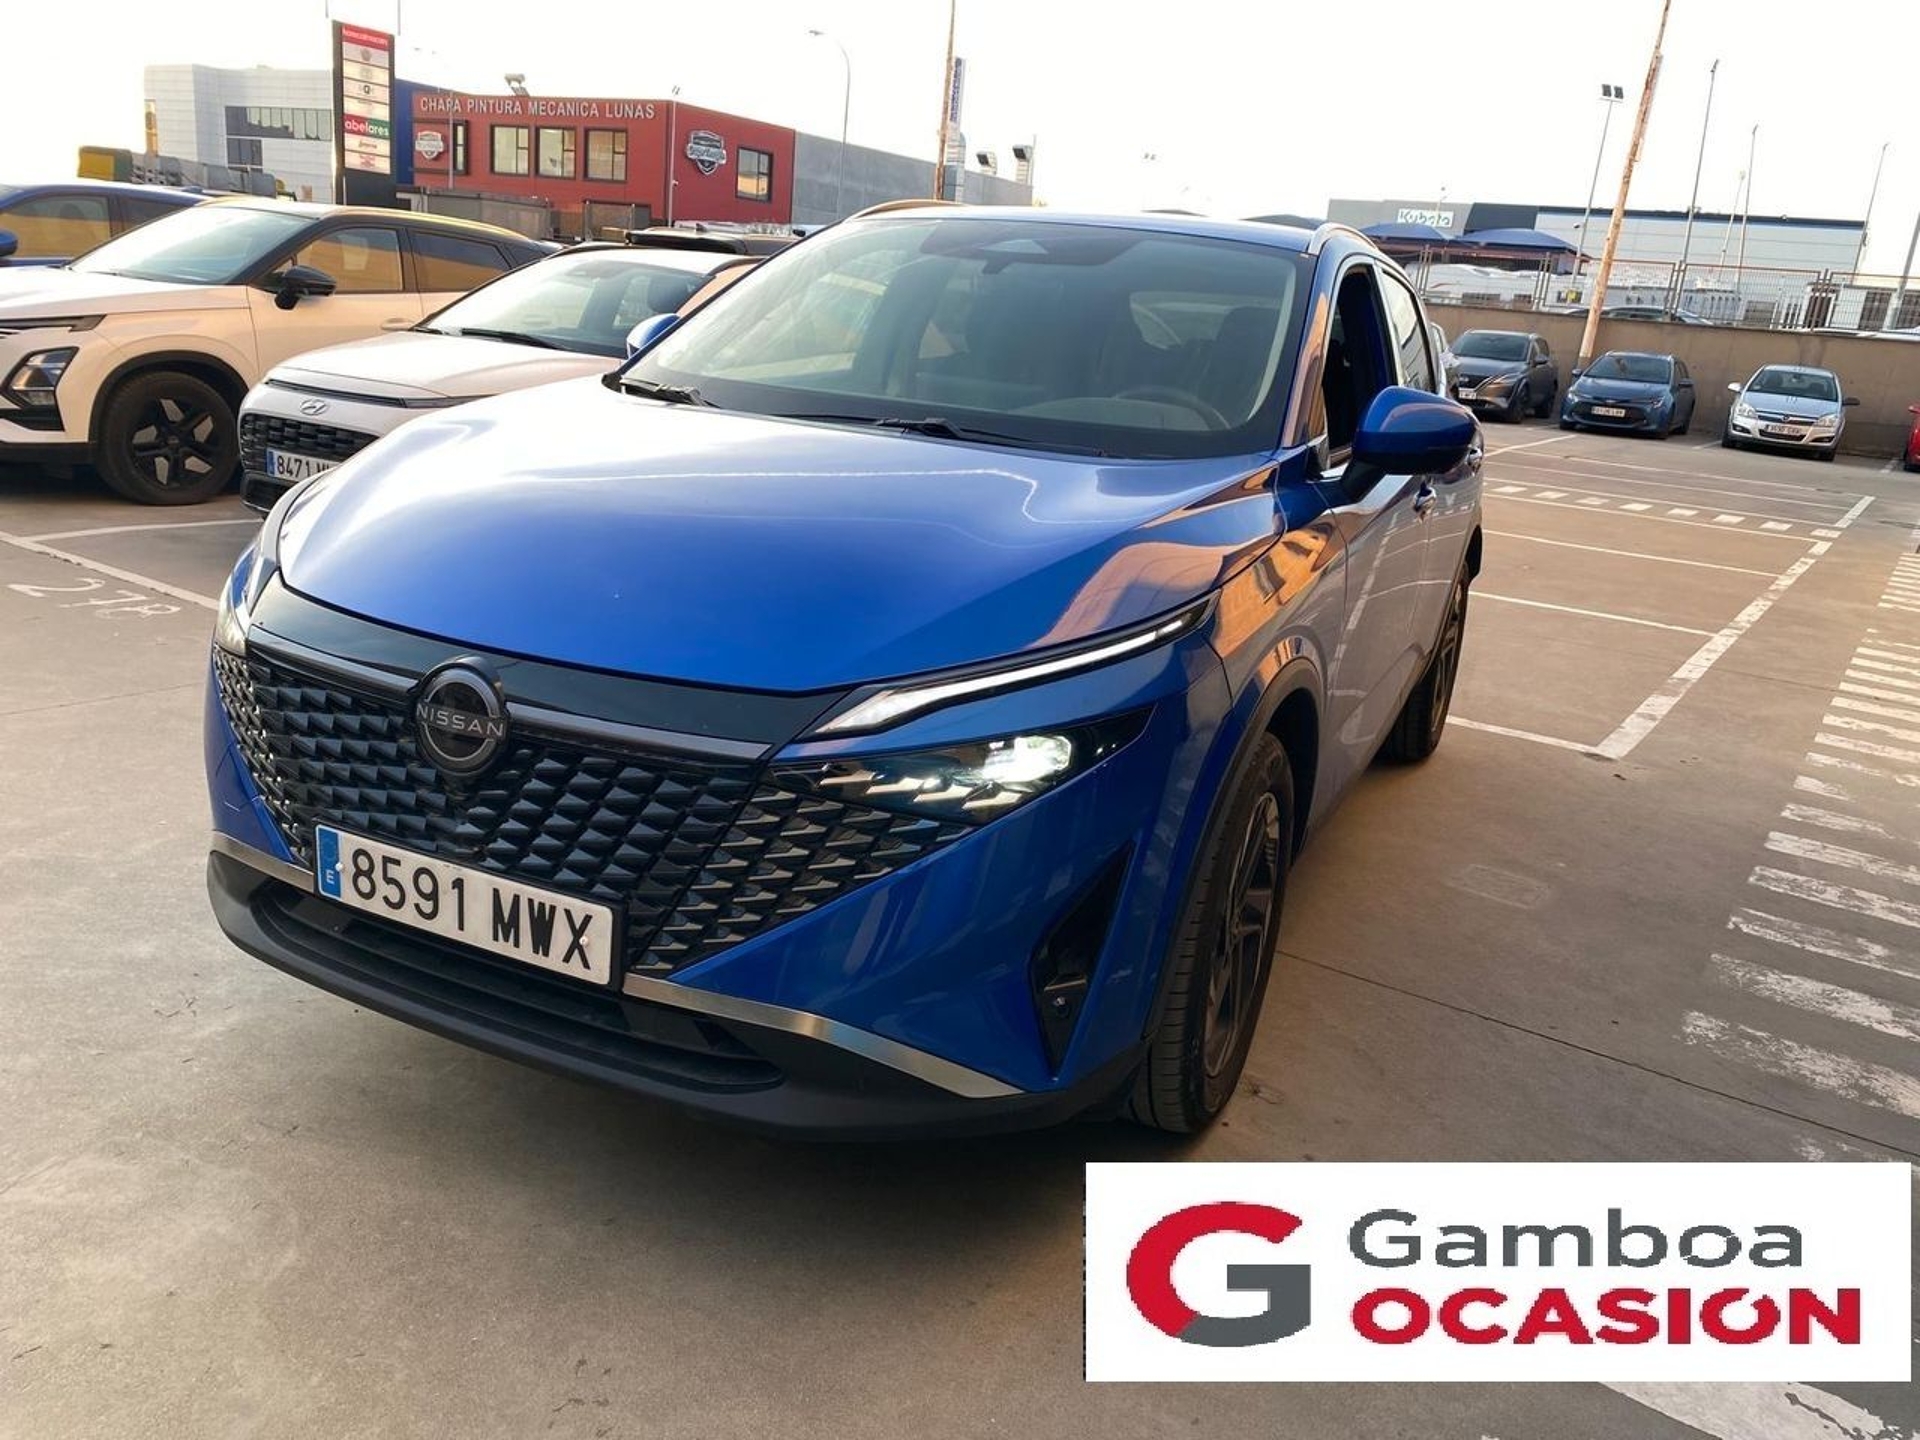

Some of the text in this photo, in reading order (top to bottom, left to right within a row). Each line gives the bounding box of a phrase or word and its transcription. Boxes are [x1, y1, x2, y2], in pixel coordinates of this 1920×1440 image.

[420, 97, 655, 118] CHAPA PINTURA MECANICA LUNAS
[277, 455, 311, 477] 8471
[415, 702, 504, 737] NISSAN
[351, 847, 593, 970] 8591 MWX
